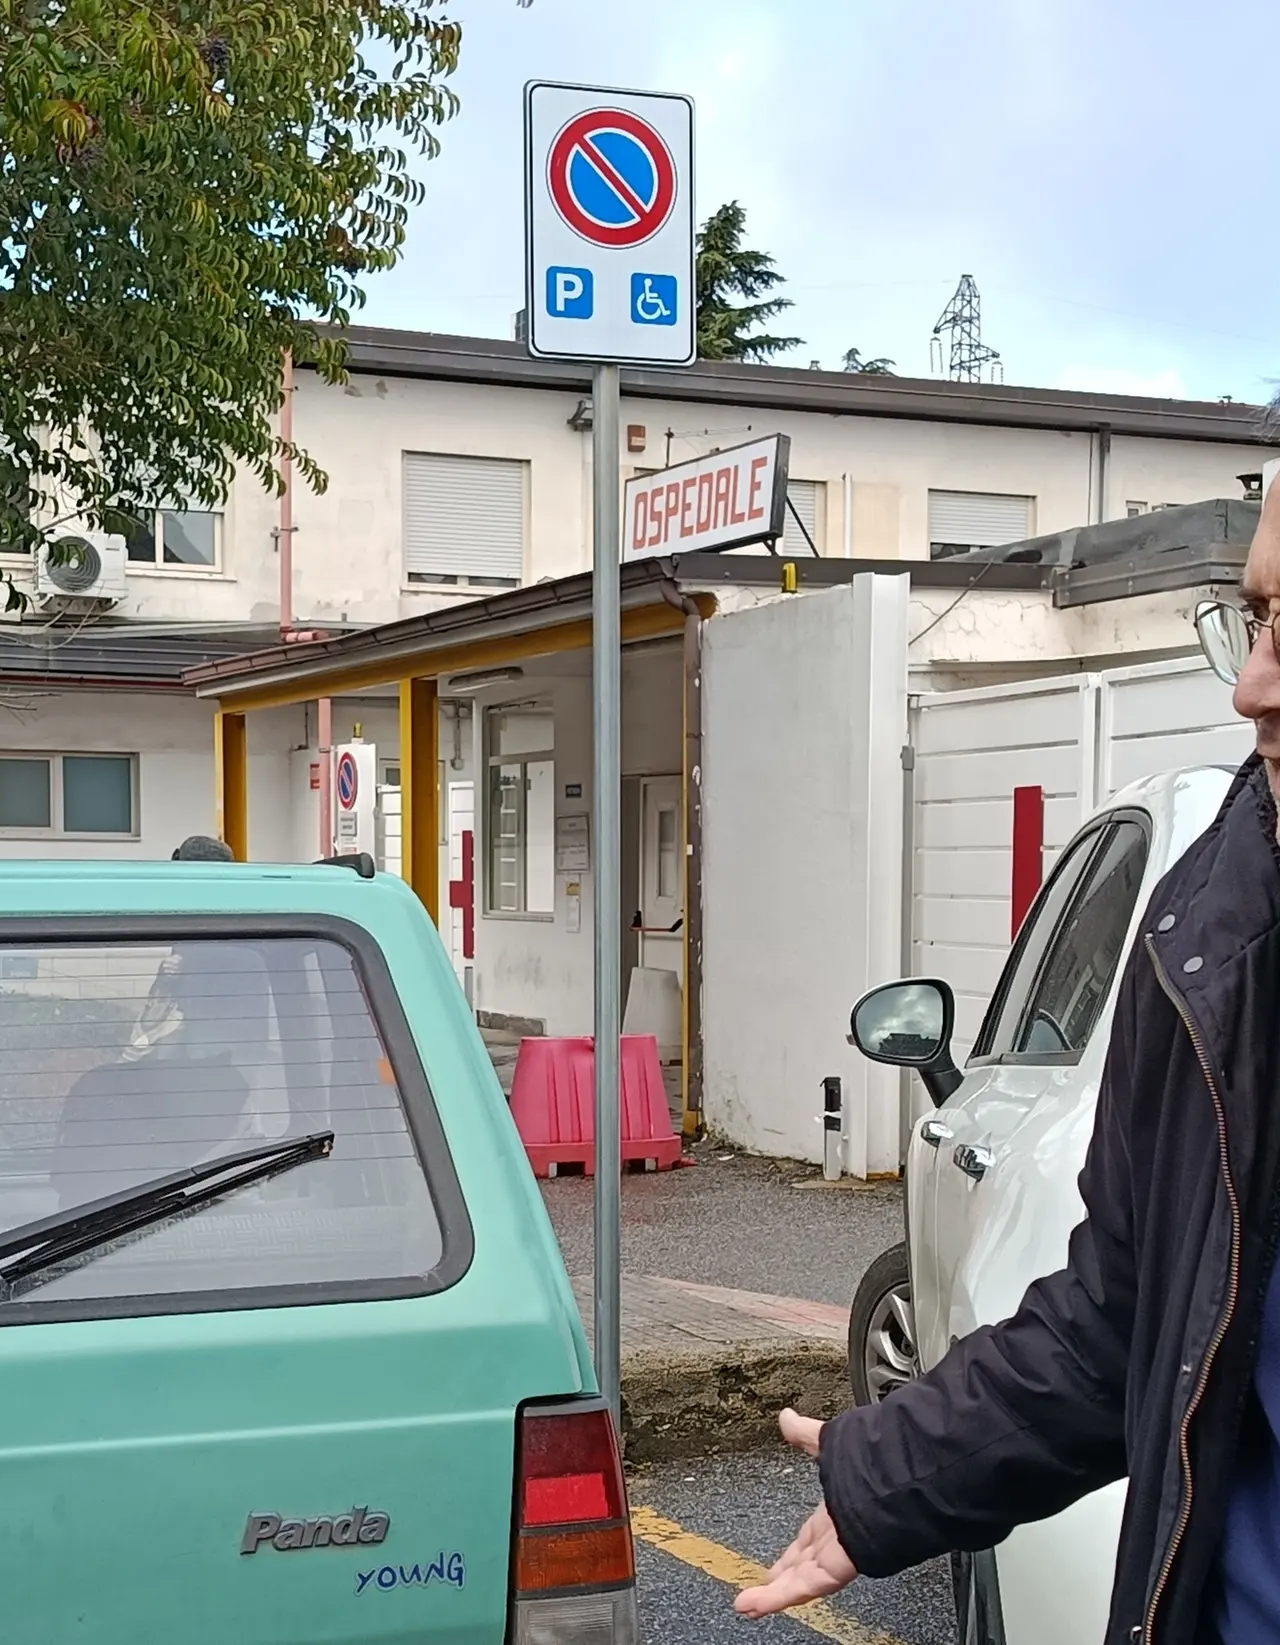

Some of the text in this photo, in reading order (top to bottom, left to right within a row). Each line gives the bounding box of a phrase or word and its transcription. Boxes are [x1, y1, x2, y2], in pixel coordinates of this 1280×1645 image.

[556, 272, 584, 312] P
[632, 456, 768, 550] OSPEDALE
[240, 1505, 390, 1555] Panda
[356, 1551, 465, 1594] YOUNG
